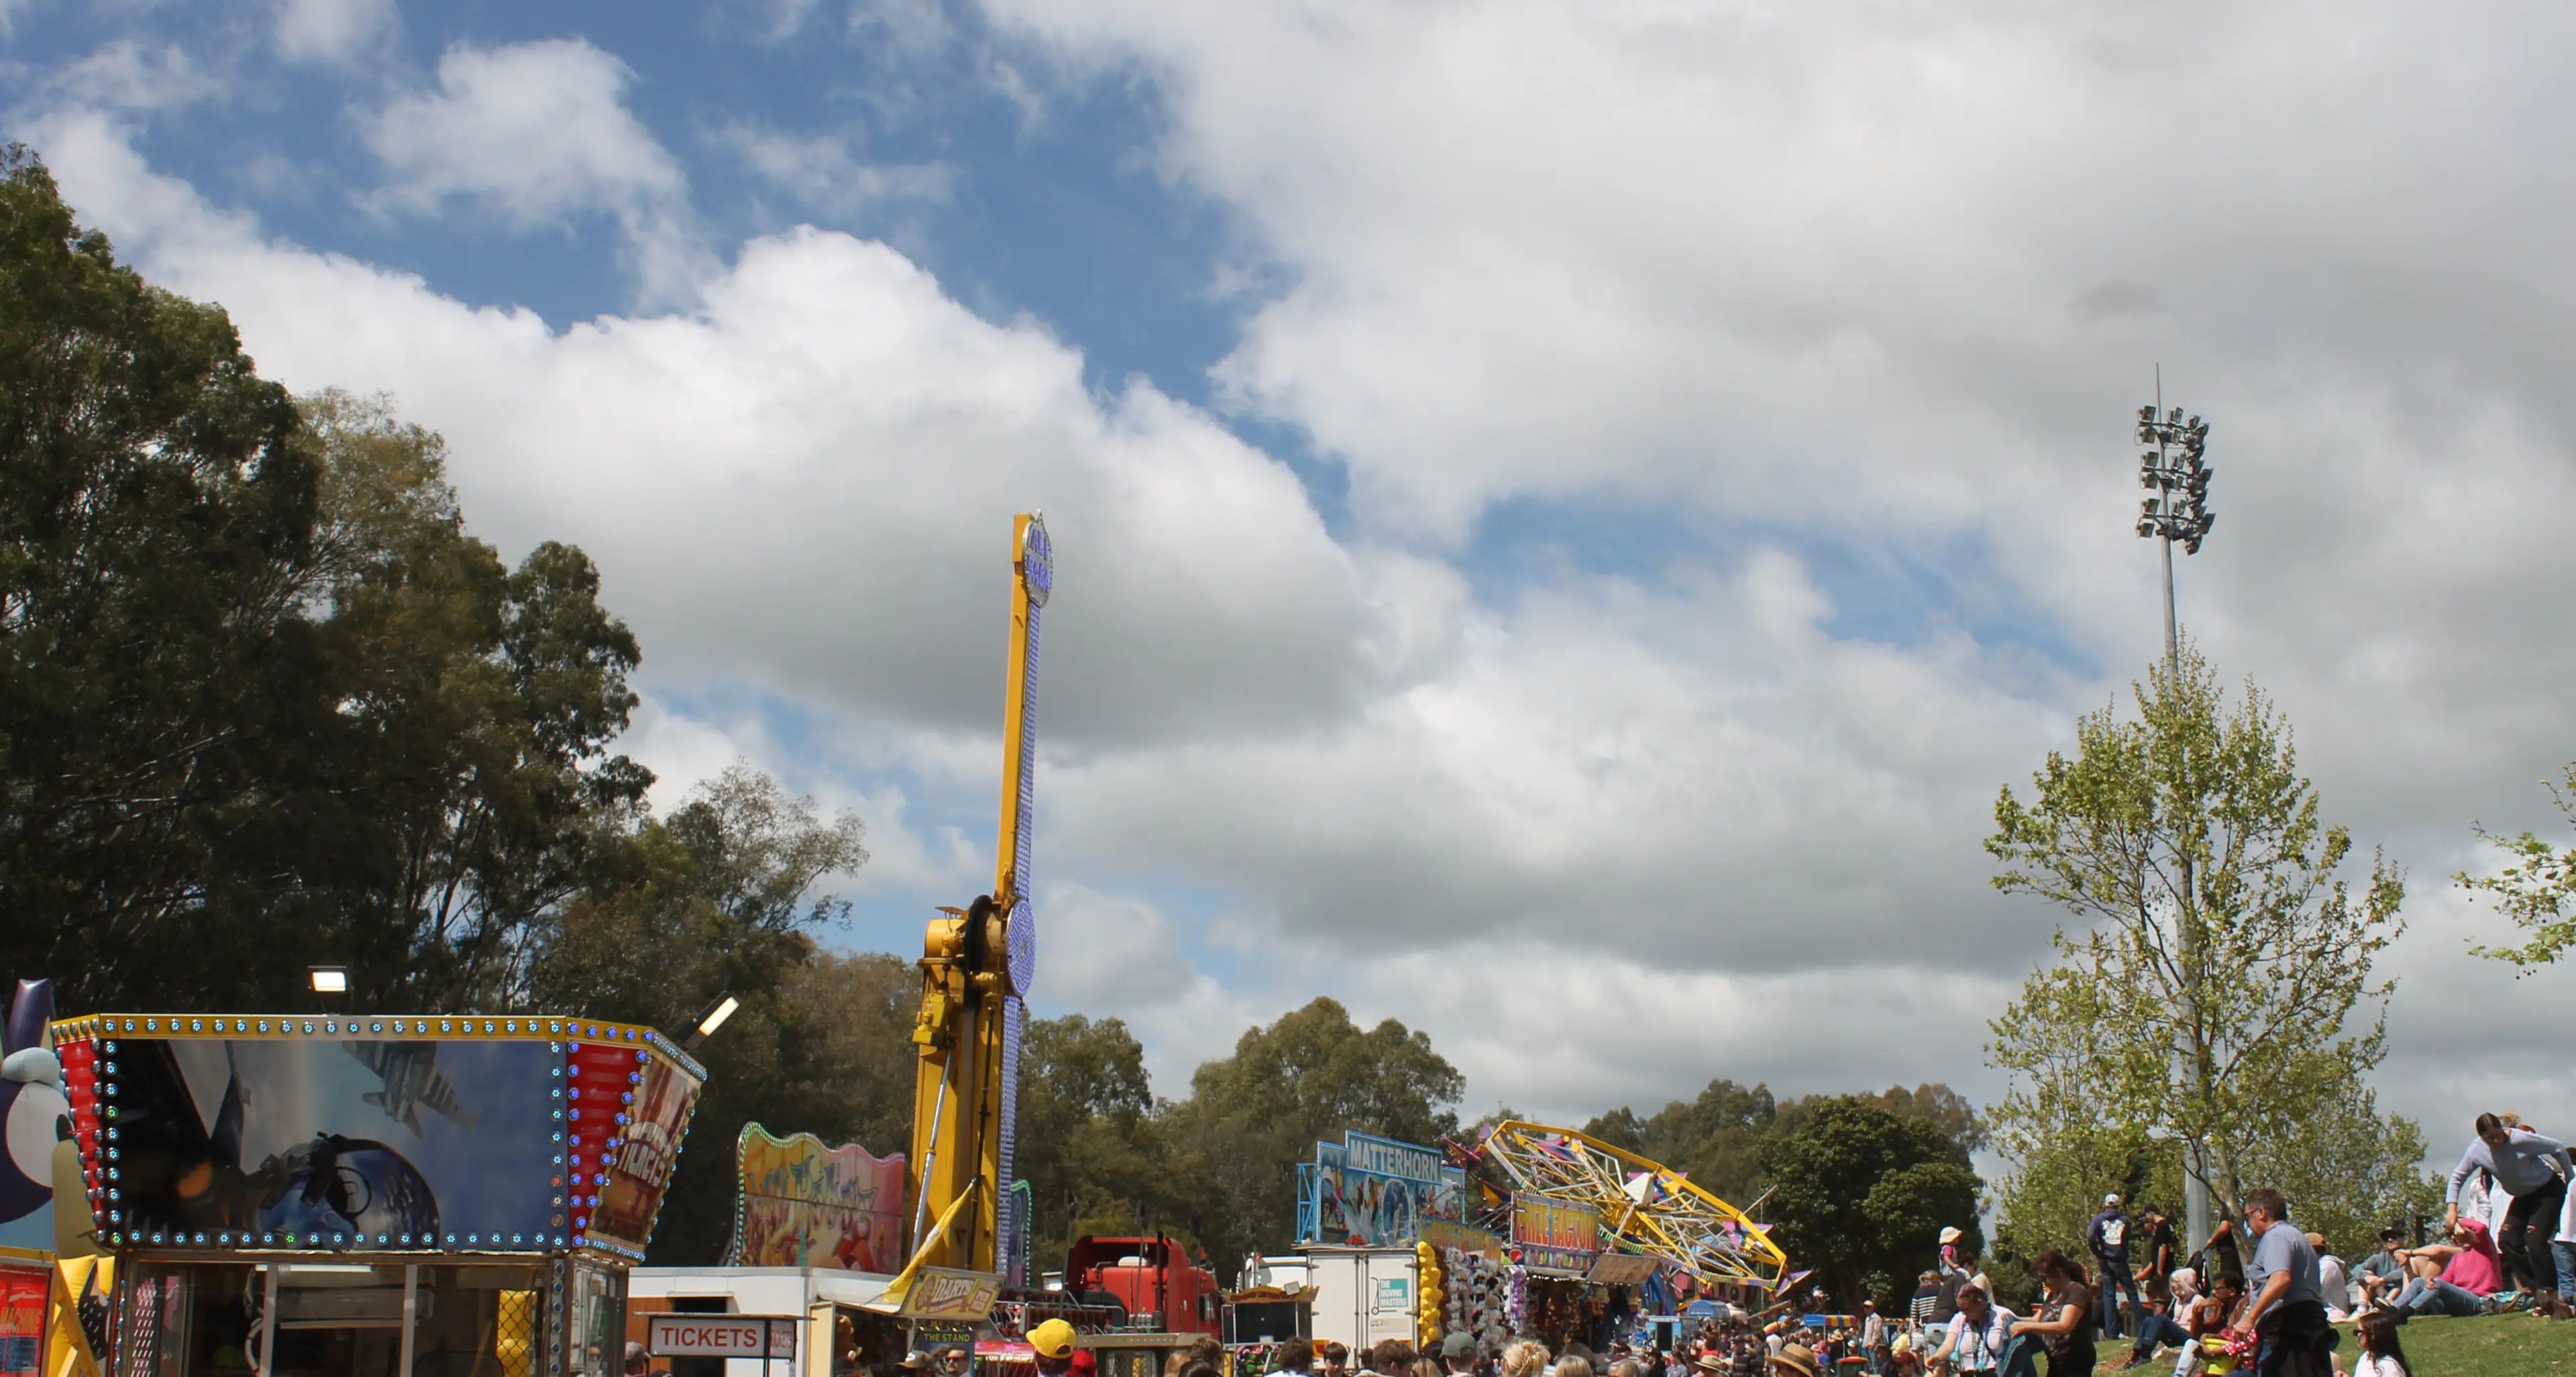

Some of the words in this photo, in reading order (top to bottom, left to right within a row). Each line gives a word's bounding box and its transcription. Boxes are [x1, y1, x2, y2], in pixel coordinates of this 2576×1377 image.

[1350, 1139, 1438, 1182] MATTERHORN
[661, 1327, 758, 1348] TICKETS
[924, 1333, 940, 1342] THE
[942, 1333, 970, 1342] STAND
